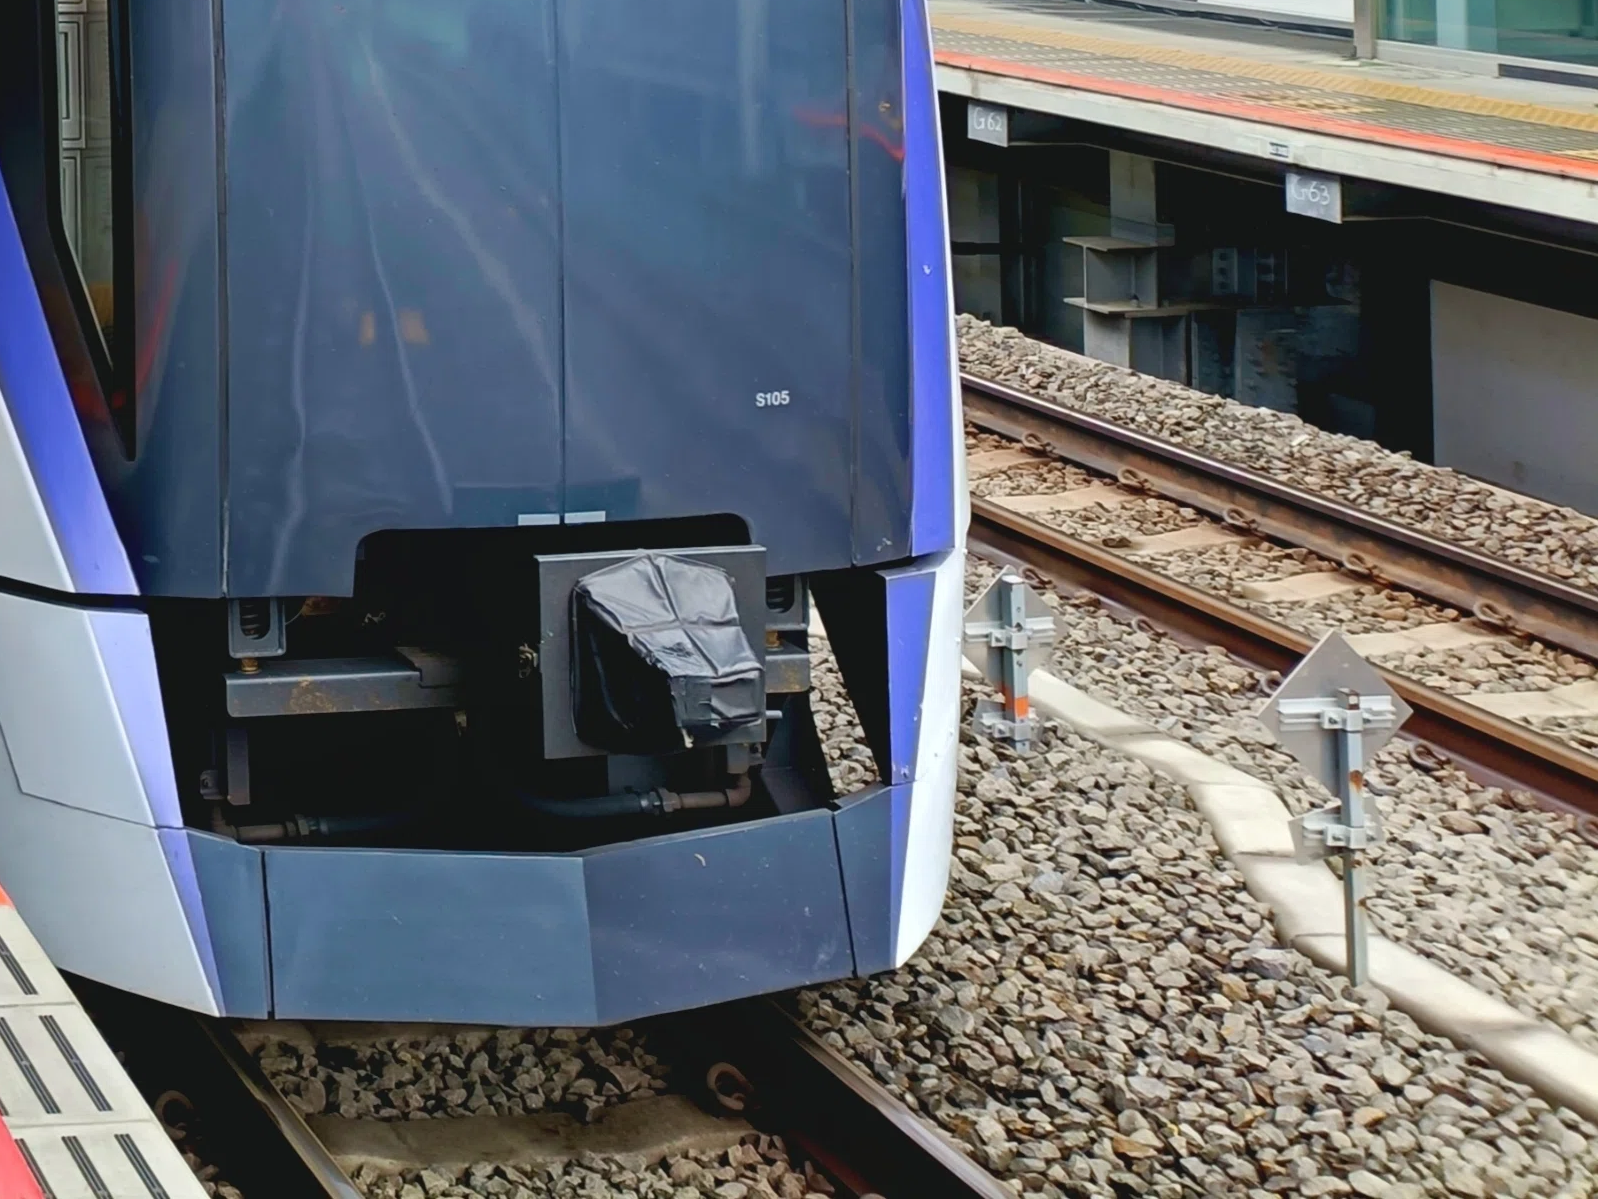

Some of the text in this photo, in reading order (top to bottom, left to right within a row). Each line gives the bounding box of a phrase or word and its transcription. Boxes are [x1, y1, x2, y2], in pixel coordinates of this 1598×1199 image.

[973, 106, 1003, 132] G62
[1289, 175, 1330, 206] G63
[755, 390, 790, 407] S105
